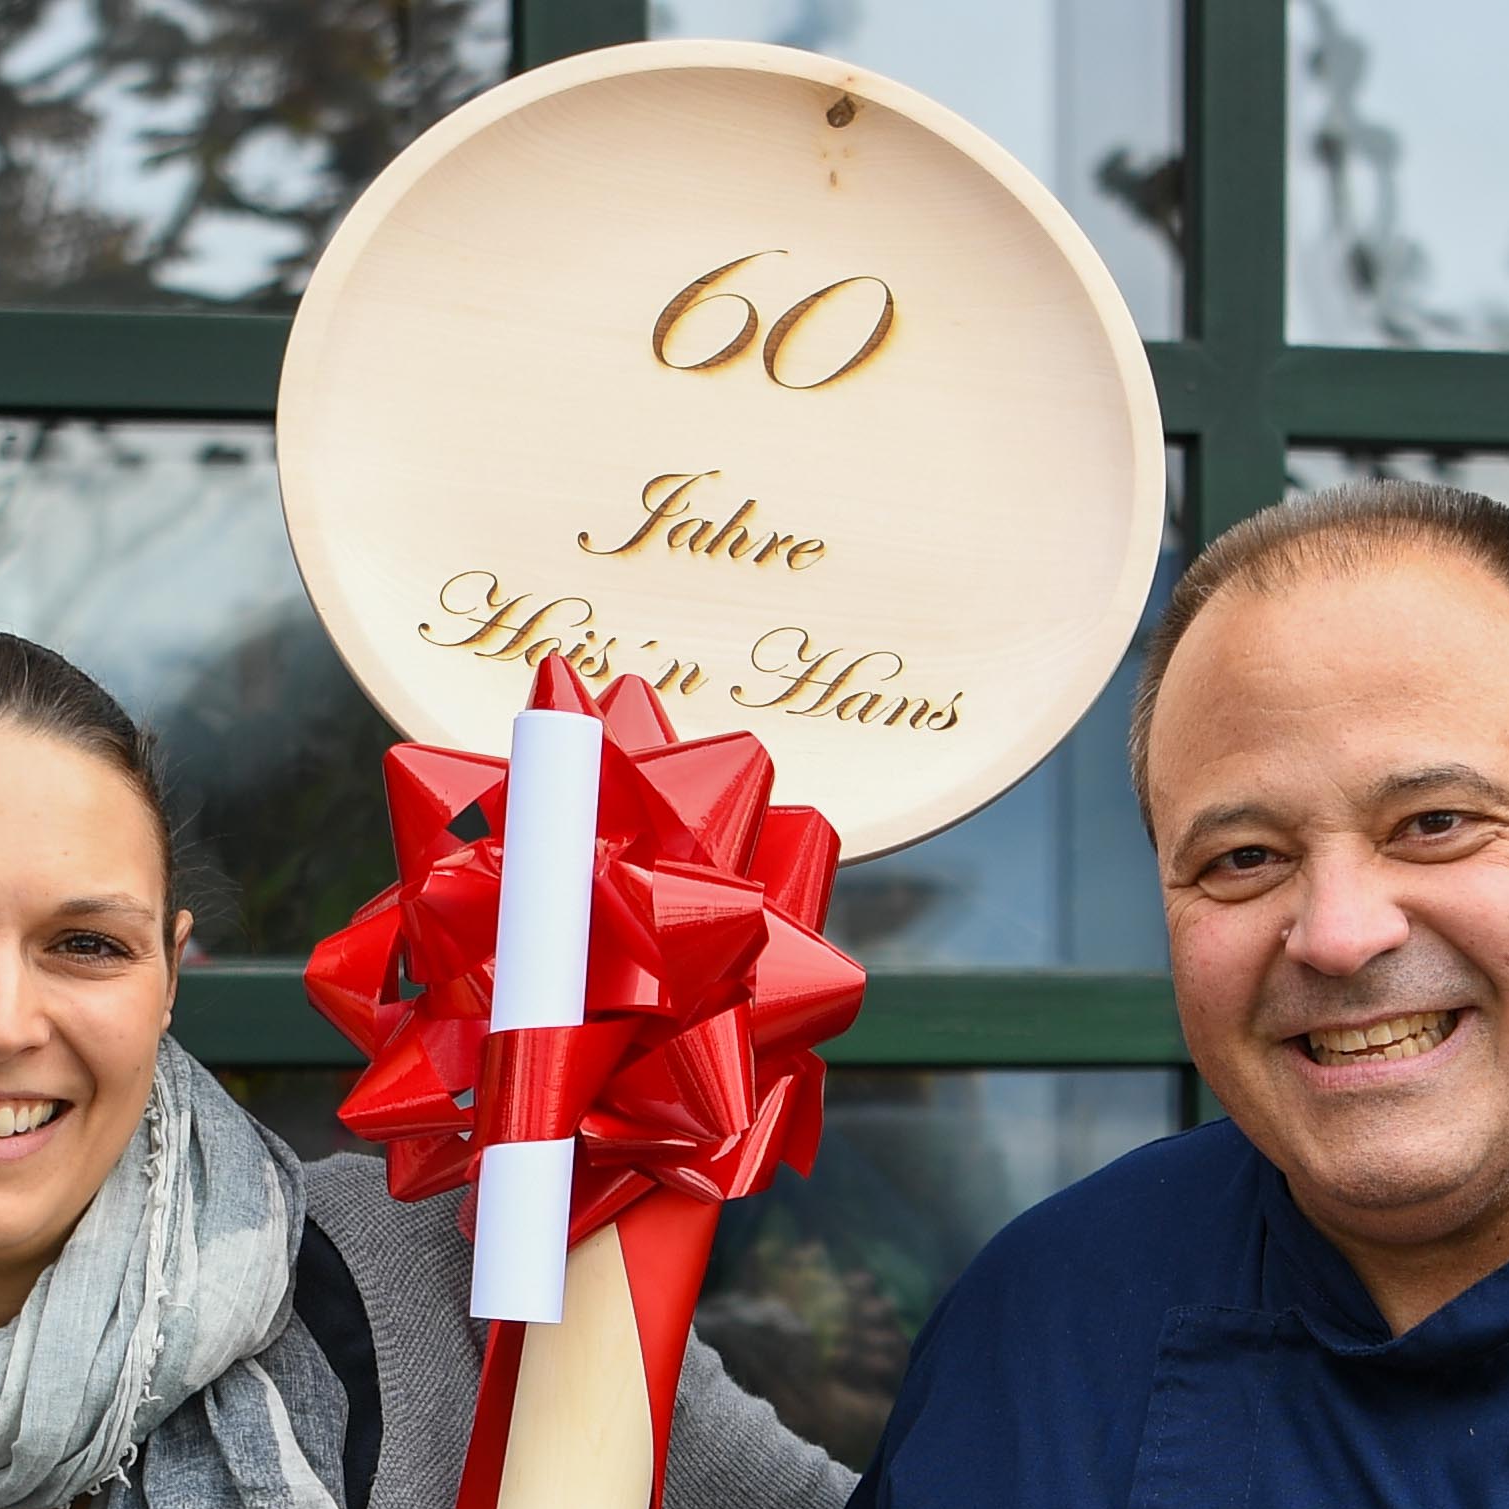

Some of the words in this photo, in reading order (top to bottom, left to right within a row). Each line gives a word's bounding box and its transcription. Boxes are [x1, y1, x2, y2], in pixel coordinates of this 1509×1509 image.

[652, 249, 894, 390] 60
[577, 469, 826, 570] Jahre
[729, 626, 964, 731] Hans
